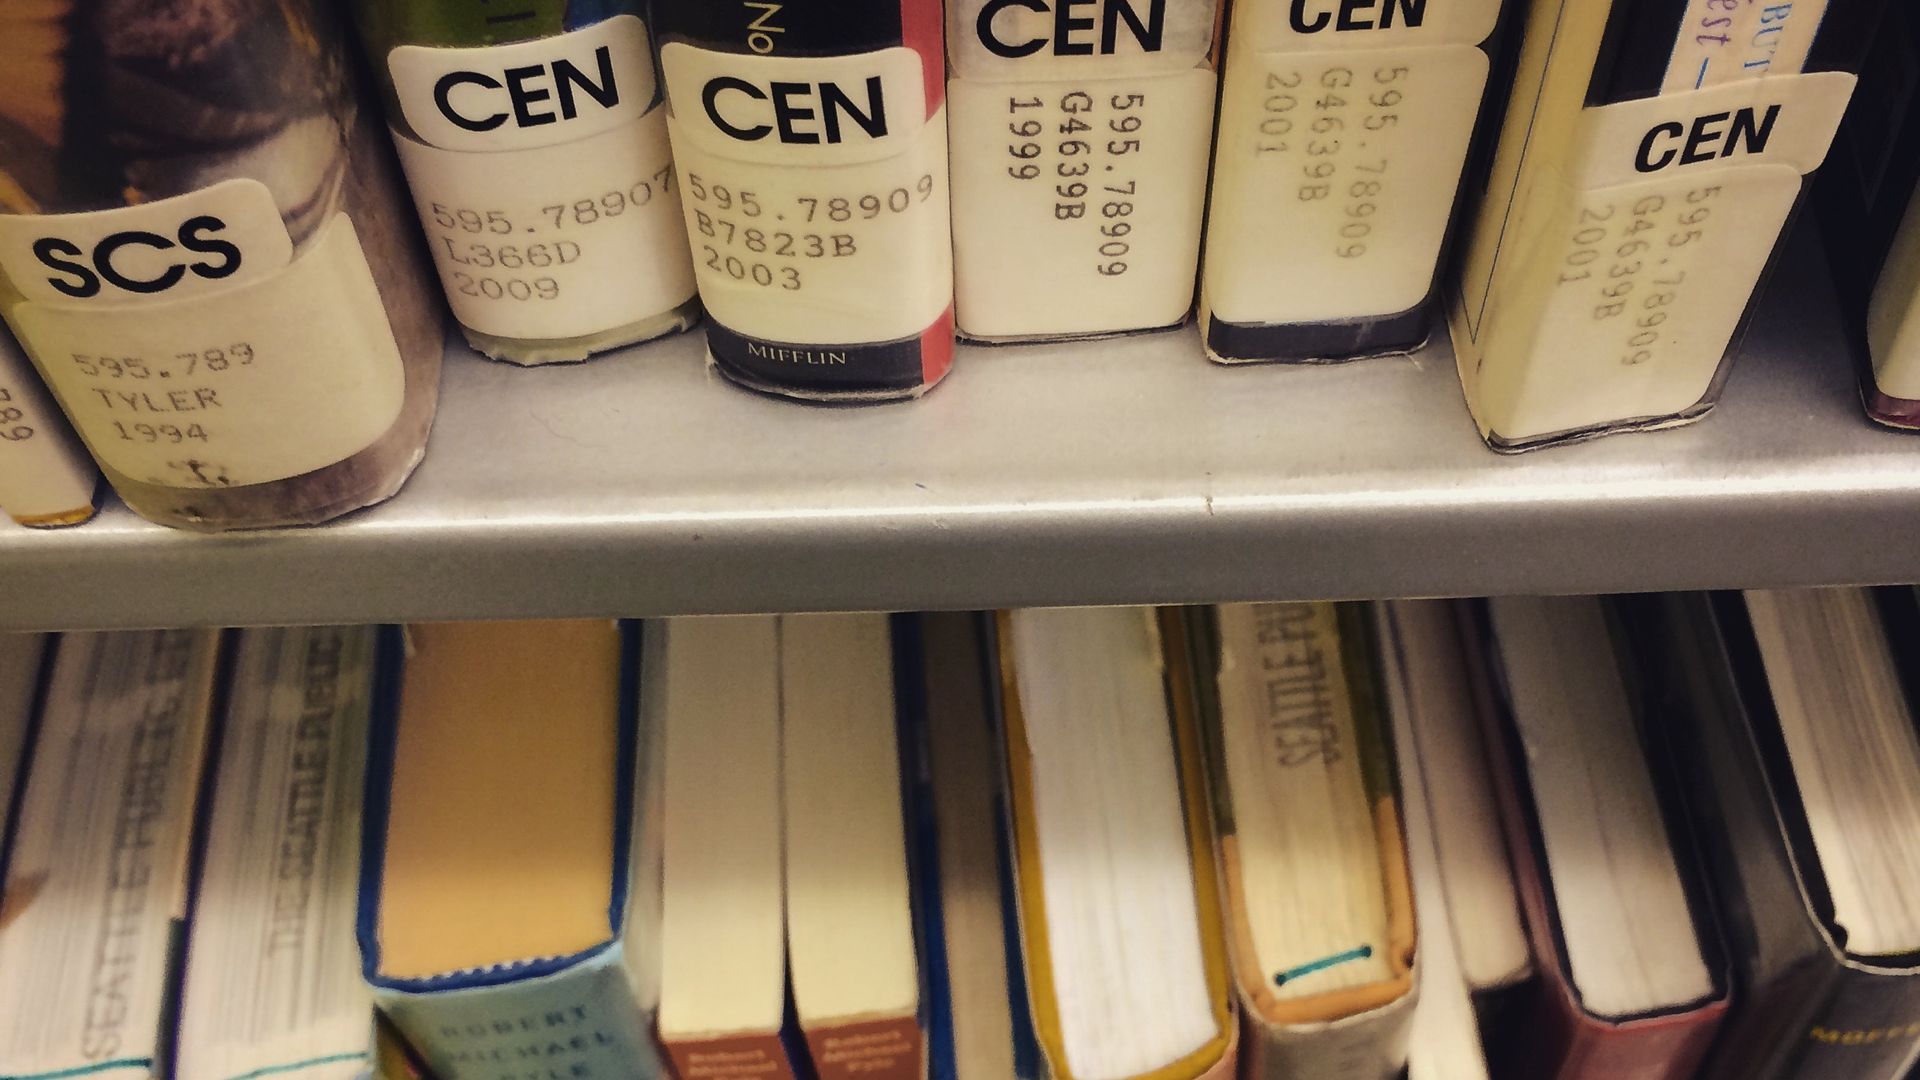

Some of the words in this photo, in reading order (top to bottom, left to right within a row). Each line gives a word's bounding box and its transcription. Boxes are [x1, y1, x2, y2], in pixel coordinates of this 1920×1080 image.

[976, 0, 1166, 58] CEN
[1288, 0, 1427, 34] CEN
[433, 46, 620, 132] CEN
[702, 76, 889, 145] CEN
[1256, 71, 1302, 159] 2001
[1008, 96, 1042, 181] 1999
[1054, 91, 1093, 221] G4639B
[1298, 67, 1353, 203] G4639B
[1336, 66, 1409, 260] 595.78909
[1634, 104, 1782, 174] CEN
[432, 165, 674, 235] 595.78907
[689, 173, 934, 224] 595.78909
[1097, 93, 1145, 277] 595.78909
[32, 215, 242, 298] SCS
[446, 240, 581, 267] L366D
[696, 210, 858, 259] B7823B
[705, 246, 803, 291] 2003
[1557, 204, 1615, 286] 2001
[1594, 194, 1665, 321] G4639B
[453, 272, 560, 301] 2009
[1621, 184, 1722, 366] 595.78909
[72, 342, 254, 379] 595.789
[748, 343, 847, 365] MIFFLIN
[91, 388, 223, 412] TYLER
[113, 421, 208, 443] 1994
